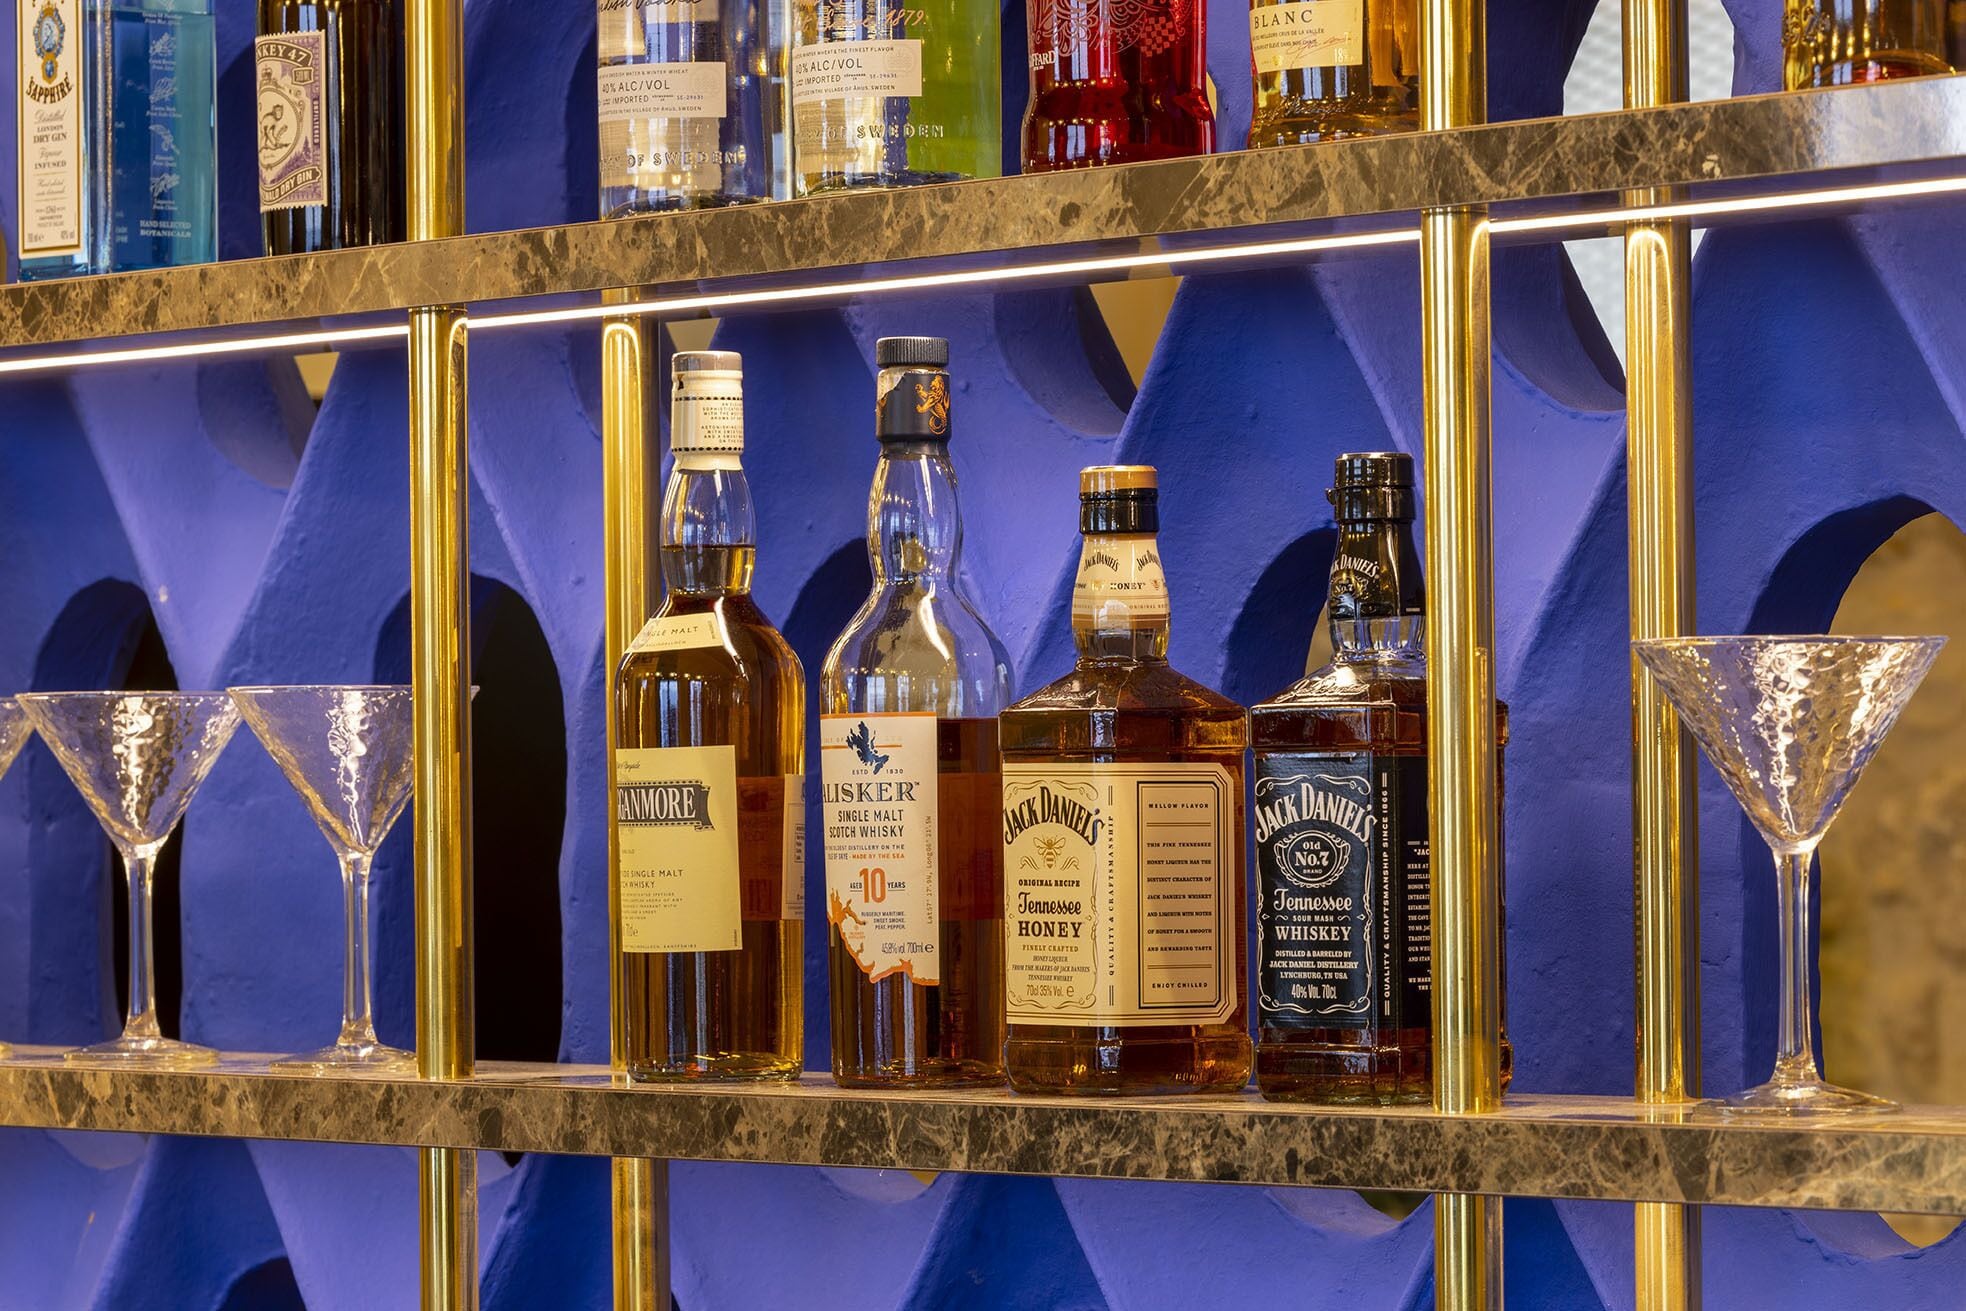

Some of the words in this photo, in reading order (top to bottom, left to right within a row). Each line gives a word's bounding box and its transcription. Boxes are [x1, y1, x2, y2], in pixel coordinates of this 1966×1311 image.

[885, 10, 927, 26] 1879.
[1254, 10, 1313, 29] BLANC
[288, 48, 307, 62] 47
[810, 58, 862, 71] ALC/VOL
[805, 74, 841, 84] IMPORTED
[26, 76, 74, 104] SAPPHIRE
[602, 83, 616, 93] 40%
[618, 80, 670, 92] ALC/VOL
[612, 95, 648, 104] IMPORTED
[856, 122, 944, 138] SWEDEN
[33, 135, 50, 144] DRY
[52, 132, 67, 142] GIN
[34, 160, 67, 170] INFUSED
[628, 154, 644, 168] OF
[653, 151, 737, 166] SWEDEN
[280, 178, 296, 195] DRY
[297, 170, 312, 184] GIN
[140, 220, 159, 228] HAND
[160, 220, 192, 229] SELECTED
[140, 230, 192, 238] BOTANICALS
[1340, 554, 1380, 578] DANIEL'S
[671, 626, 698, 634] MALT
[838, 810, 869, 822] SINGLE
[874, 809, 904, 822] MALT
[1004, 796, 1040, 846] JACK
[1040, 786, 1105, 846] DANIEL'S
[1255, 794, 1300, 842] JACK
[1301, 782, 1378, 842] DANIEL'S
[830, 826, 856, 838] SCOTCH
[860, 825, 904, 838] WHISKY
[1303, 842, 1321, 850] Old
[1295, 851, 1329, 866] No.7
[850, 882, 862, 890] AGED
[860, 868, 886, 903] 10
[1018, 892, 1081, 915] Tennessee
[1274, 888, 1352, 911] Tennessee
[1018, 921, 1082, 938] HONEY
[1275, 926, 1351, 940] WHISKEY
[1027, 985, 1039, 996] 70cl
[1040, 985, 1052, 996] 35%
[1292, 984, 1307, 999] 40%
